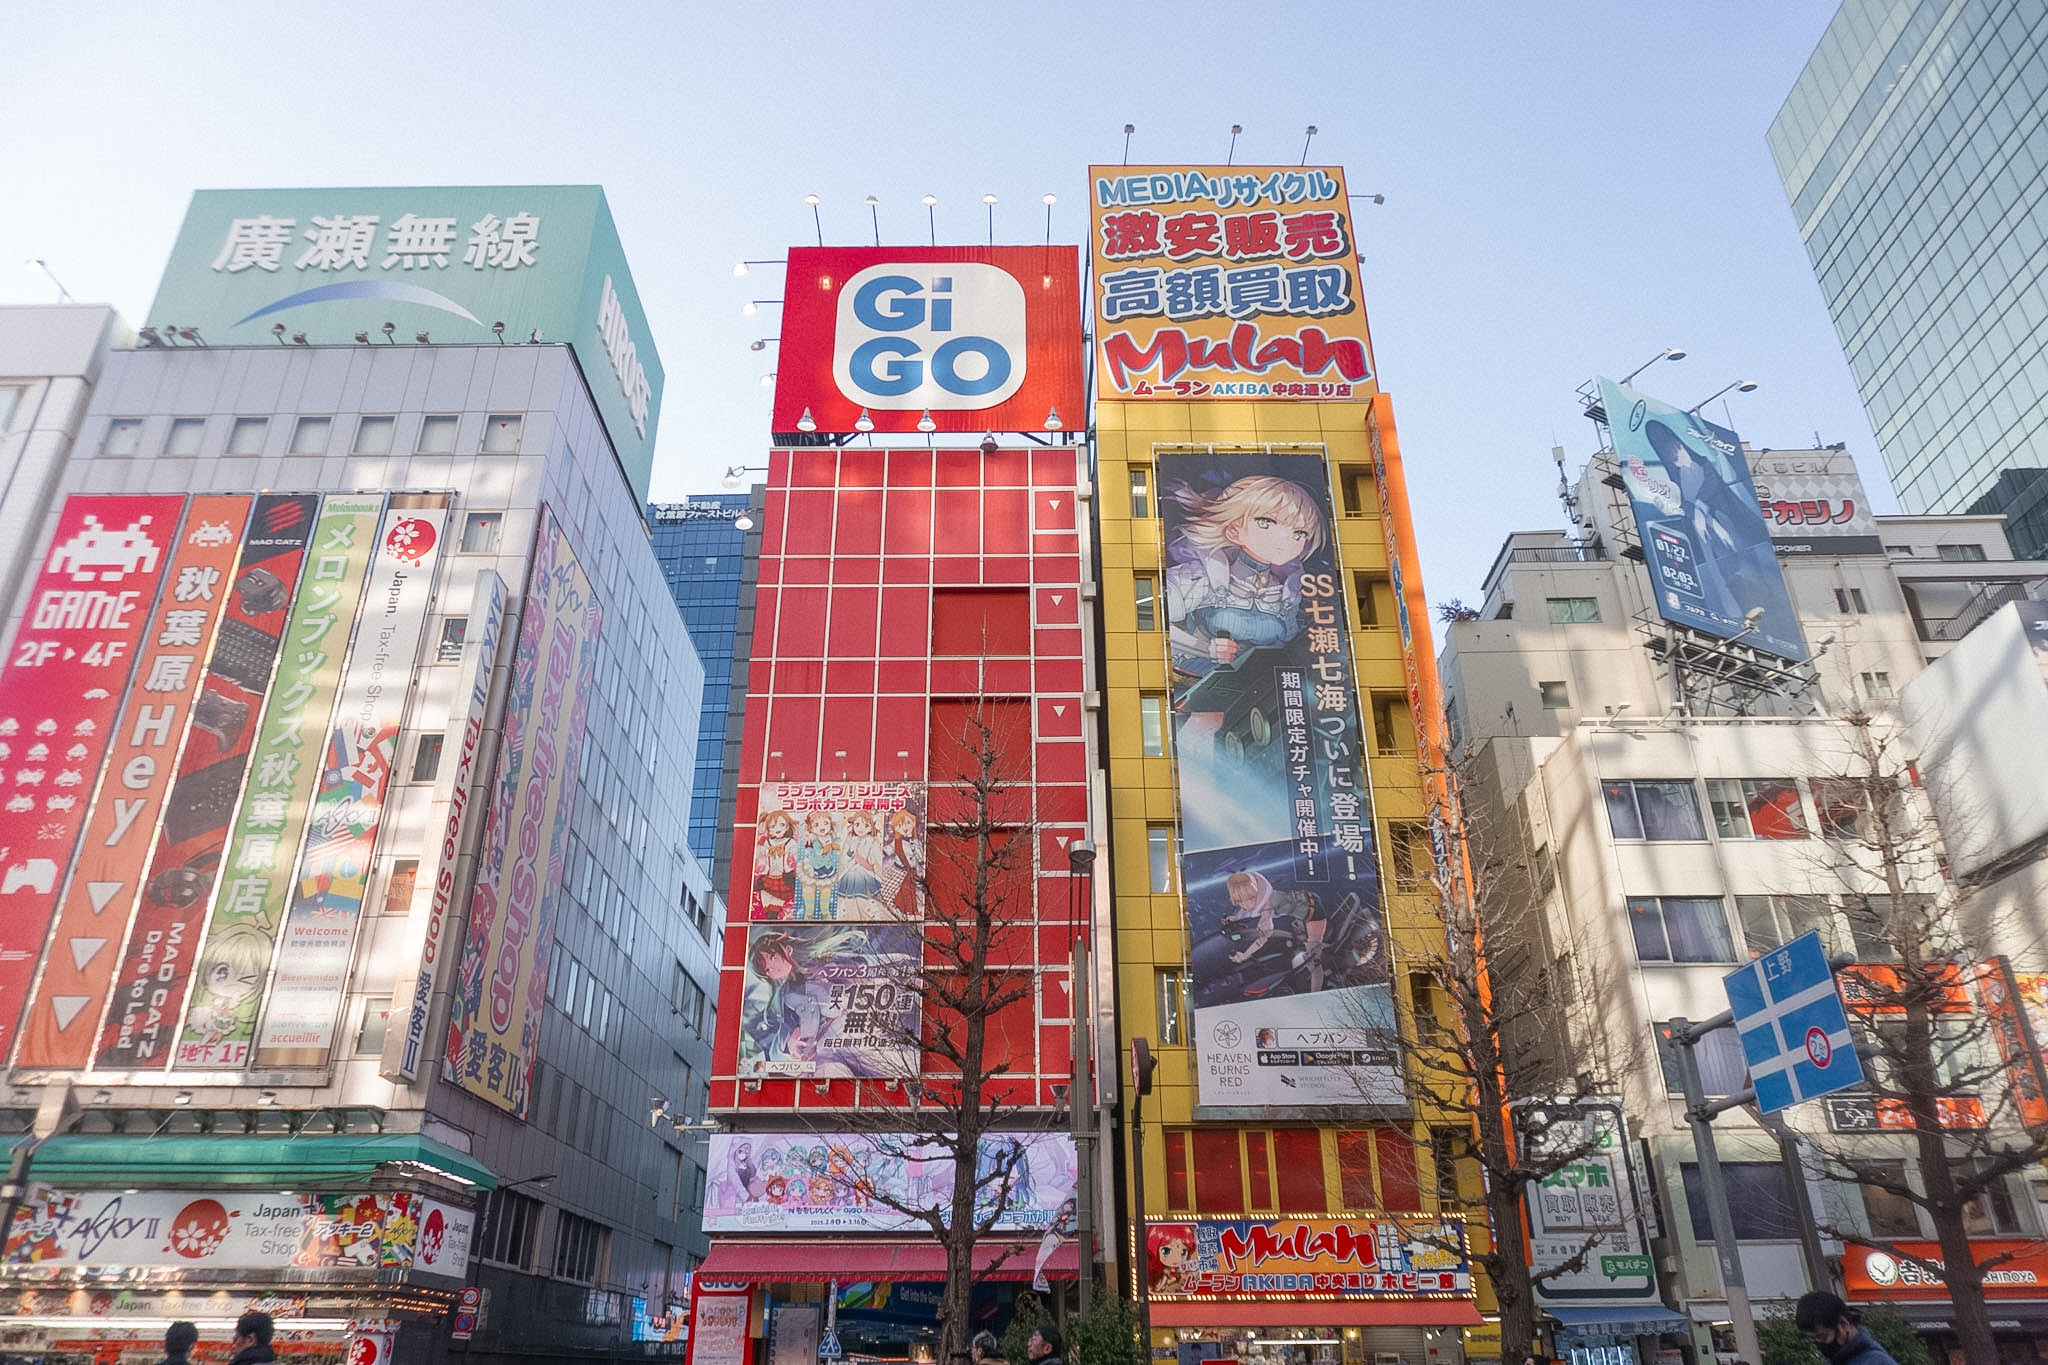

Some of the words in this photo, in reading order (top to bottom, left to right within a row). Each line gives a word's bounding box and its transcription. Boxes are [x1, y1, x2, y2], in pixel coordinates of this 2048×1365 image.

[1097, 171, 1338, 207] MEDIAリサイクル
[211, 211, 540, 273] 廣瀬無線
[1103, 211, 1342, 257] 激安販売
[1102, 267, 1344, 317] 高額買取
[1104, 322, 1371, 390] Mulan
[1133, 381, 1211, 396] ムーラン
[1212, 382, 1269, 395] AKIBA
[1272, 382, 1352, 397] 中央通り店
[249, 538, 275, 546] MAD
[32, 590, 141, 629] GAME
[385, 570, 408, 618] Japan.
[14, 641, 61, 667] 2F
[80, 641, 128, 667] 4F
[370, 624, 396, 681] Tax-free
[223, 523, 357, 913] メロンブックス秋葉原店
[1300, 574, 1364, 881] SS七瀬七海ついに登場!
[519, 615, 577, 864] Tax-free
[444, 716, 482, 860] Tax-free
[777, 784, 912, 798] ラブライブ!シリーズ
[1281, 671, 1319, 876] 期間限定ガチャ開催中!
[294, 927, 349, 936] Welcome
[424, 866, 452, 964] Shop
[157, 922, 186, 982] MAD
[489, 856, 538, 1036] Shop
[137, 988, 169, 1058] CATZ
[1297, 1033, 1350, 1045] ヘブバン
[1207, 1053, 1252, 1064] HEAVEN
[1210, 1065, 1250, 1076] BURNS
[1270, 1053, 1282, 1061] App
[1219, 1077, 1243, 1087] RED
[1545, 1194, 1577, 1214] 買取
[244, 1222, 300, 1239] Tax-free
[260, 1240, 297, 1257] Shop
[315, 1221, 374, 1237] アッキー2
[1220, 1224, 1377, 1271] Mulan
[1183, 1275, 1241, 1292] ムーラン
[1242, 1275, 1313, 1291] AKIBA
